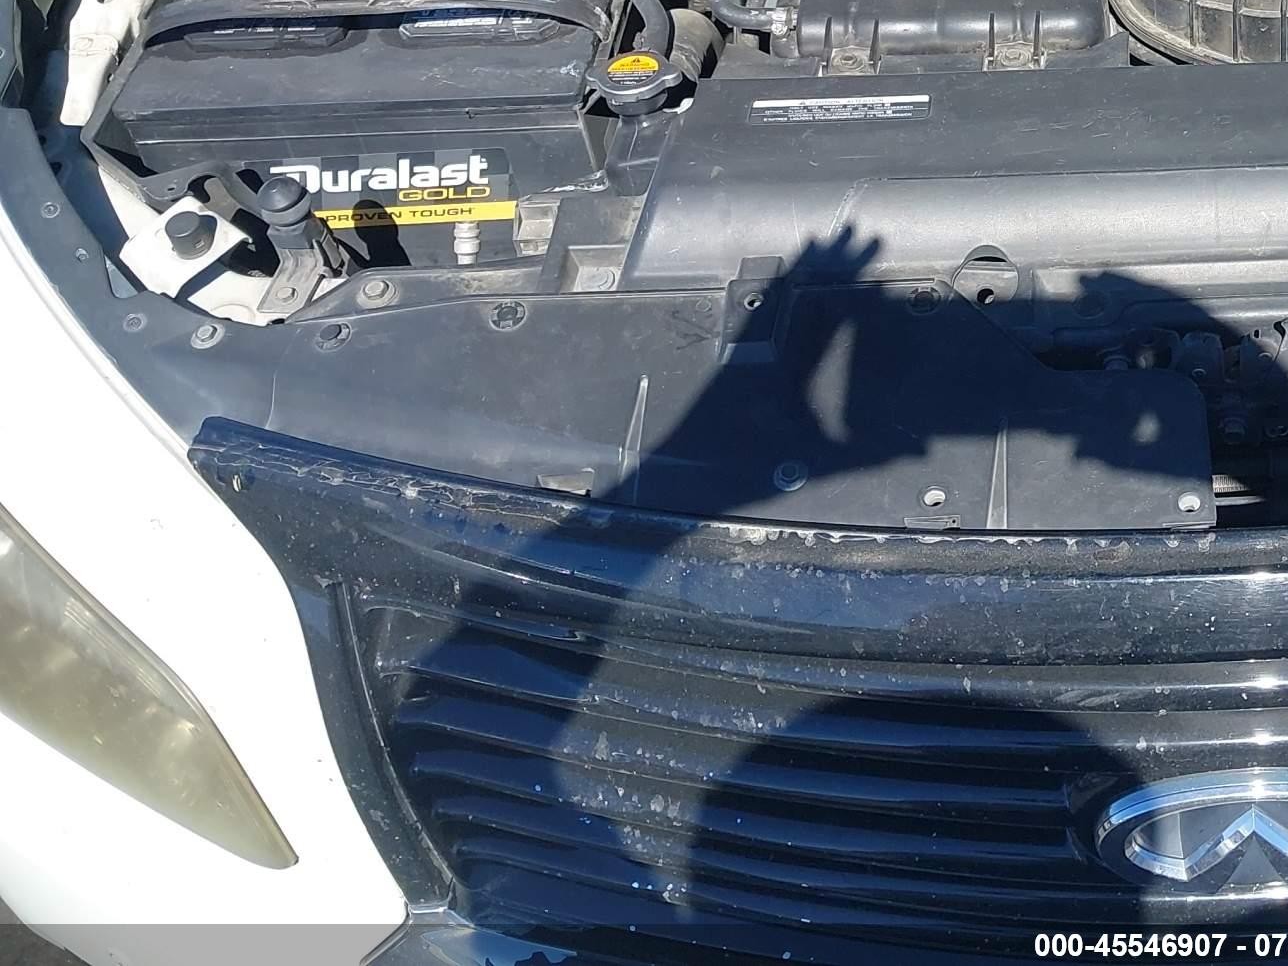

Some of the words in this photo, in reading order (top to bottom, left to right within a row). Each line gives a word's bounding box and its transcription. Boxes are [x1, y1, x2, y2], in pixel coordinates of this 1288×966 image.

[269, 154, 490, 194] Duralast
[398, 186, 491, 202] GOLD
[325, 211, 402, 223] PROVEN
[408, 207, 474, 219] TOUGH
